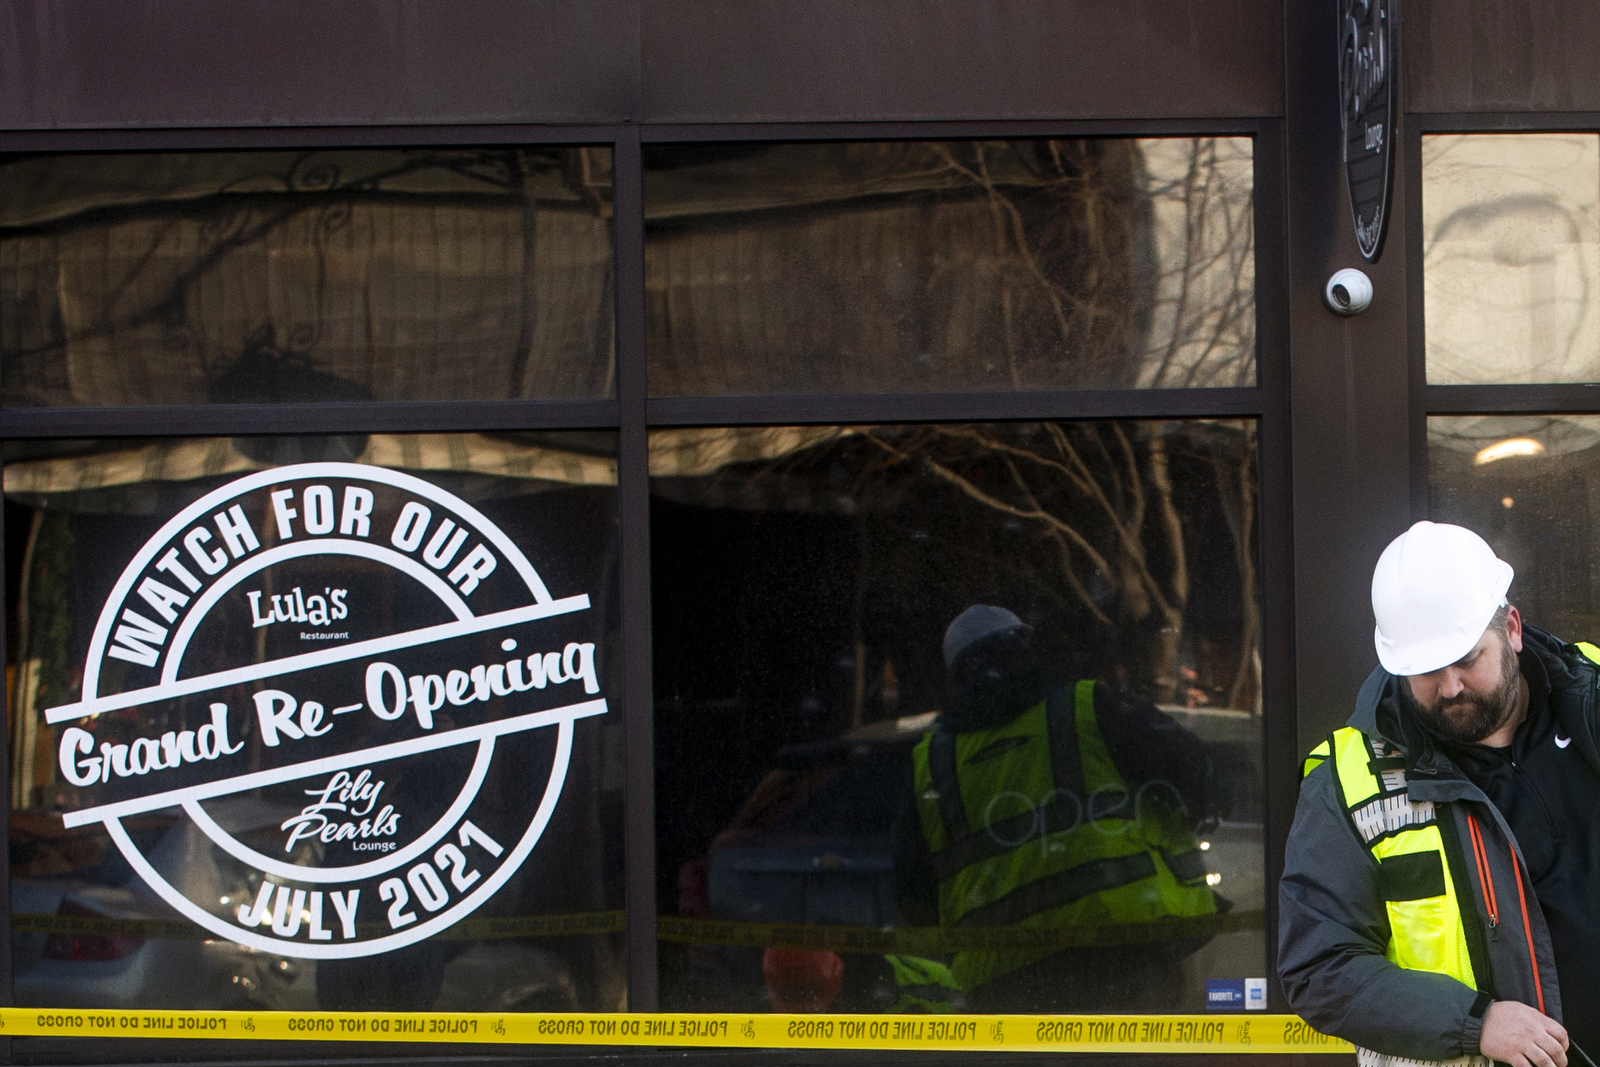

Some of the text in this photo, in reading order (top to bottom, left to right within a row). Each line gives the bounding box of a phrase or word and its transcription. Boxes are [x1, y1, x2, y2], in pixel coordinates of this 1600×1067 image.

[108, 484, 498, 670] WATCH FOR OUR
[247, 586, 348, 629] Lula's
[299, 631, 349, 640] Restaurant
[58, 638, 600, 788] Grand Re-Opening
[302, 769, 387, 816] Lily
[280, 803, 402, 853] Pearls
[352, 839, 397, 852] Lounge
[237, 818, 504, 941] JULY 2021
